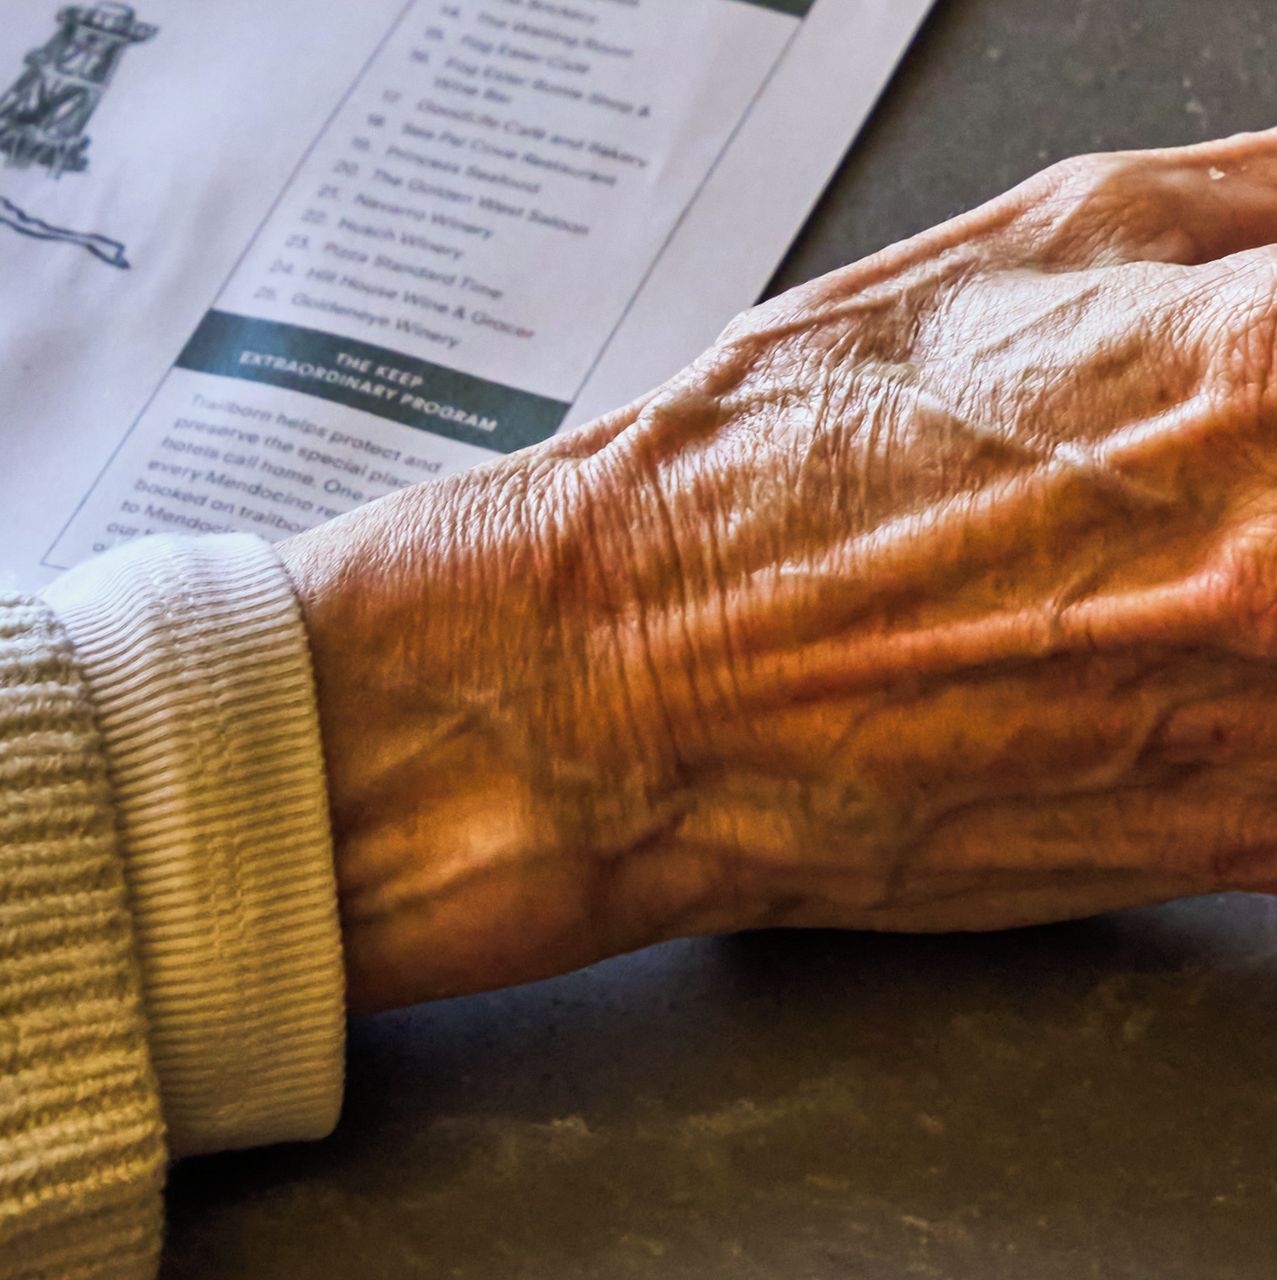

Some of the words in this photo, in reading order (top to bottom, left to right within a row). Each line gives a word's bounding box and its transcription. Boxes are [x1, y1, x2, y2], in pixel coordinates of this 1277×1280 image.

[239, 350, 396, 398] EXTRAORDINARY
[400, 393, 497, 431] PROGRAM
[337, 353, 370, 372] THE
[375, 366, 422, 386] KEEP
[161, 436, 219, 459] hotels
[222, 452, 258, 468] call
[322, 478, 363, 502] One
[174, 418, 259, 444] preserve
[264, 436, 293, 452] the
[297, 447, 367, 476] special
[366, 470, 409, 489] plac
[274, 411, 329, 439] helps
[326, 430, 402, 462] protect
[401, 454, 444, 475] and
[134, 479, 208, 506] booked
[210, 500, 234, 515] on
[237, 506, 307, 534] trailbor
[147, 460, 201, 482] every
[204, 470, 314, 511] Mendocino
[106, 522, 140, 538] our
[121, 500, 139, 512] to
[144, 504, 236, 534] Mendoci
